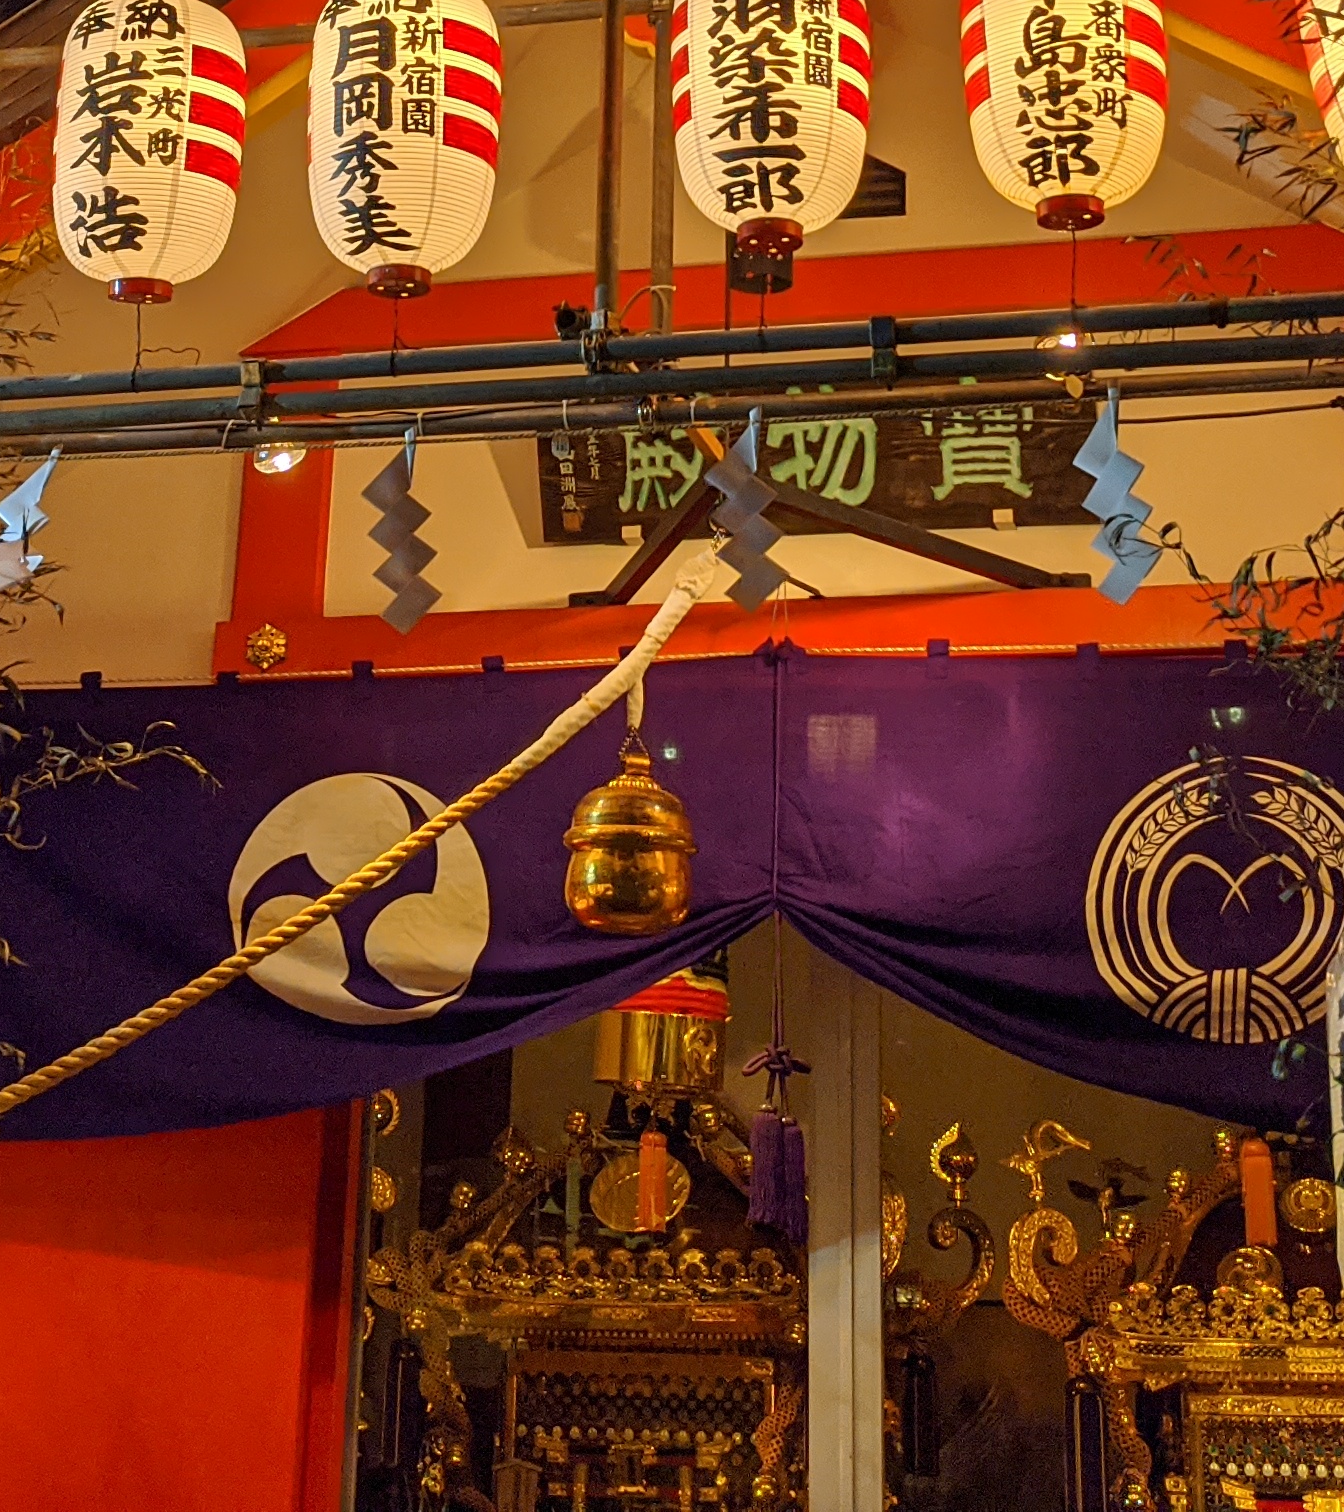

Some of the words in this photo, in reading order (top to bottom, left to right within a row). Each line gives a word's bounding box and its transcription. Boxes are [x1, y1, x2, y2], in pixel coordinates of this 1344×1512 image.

[68, 49, 153, 261] 岩本浩
[144, 44, 191, 168] 三光町
[328, 15, 425, 257] 月岡秀美
[397, 14, 446, 140] 新宿園
